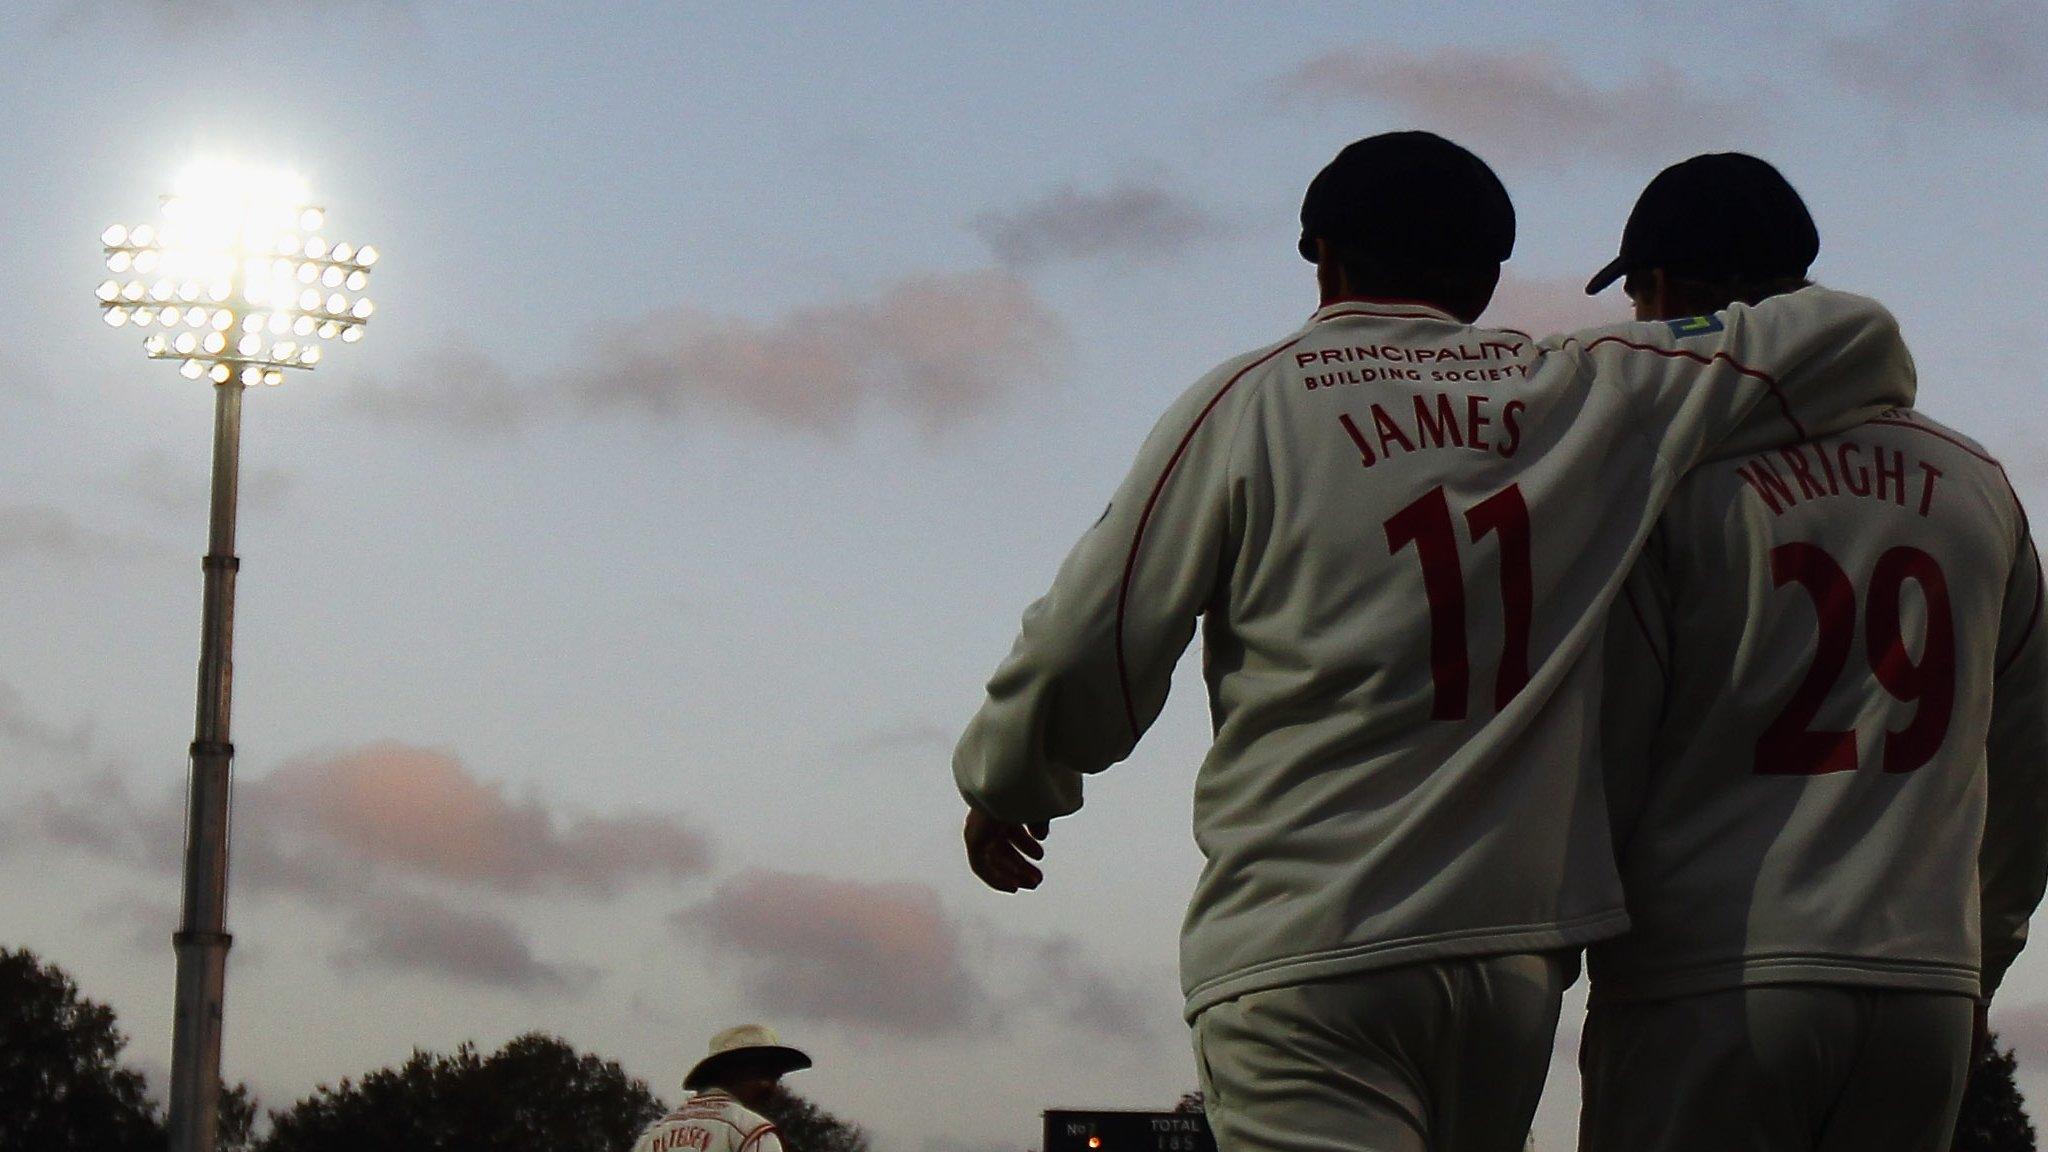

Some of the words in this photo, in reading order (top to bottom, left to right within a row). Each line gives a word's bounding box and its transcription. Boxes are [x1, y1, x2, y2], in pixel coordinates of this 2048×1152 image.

[1295, 342, 1524, 369] PRINCIPALITY
[1304, 366, 1422, 390] BUILDING
[1430, 364, 1529, 382] SOCIETY
[1338, 392, 1526, 469] JAMES
[1735, 441, 1943, 518] WRIGHT
[1382, 482, 1534, 721] 11
[1753, 541, 1956, 776] 29
[1151, 1119, 1199, 1132] TOTAL
